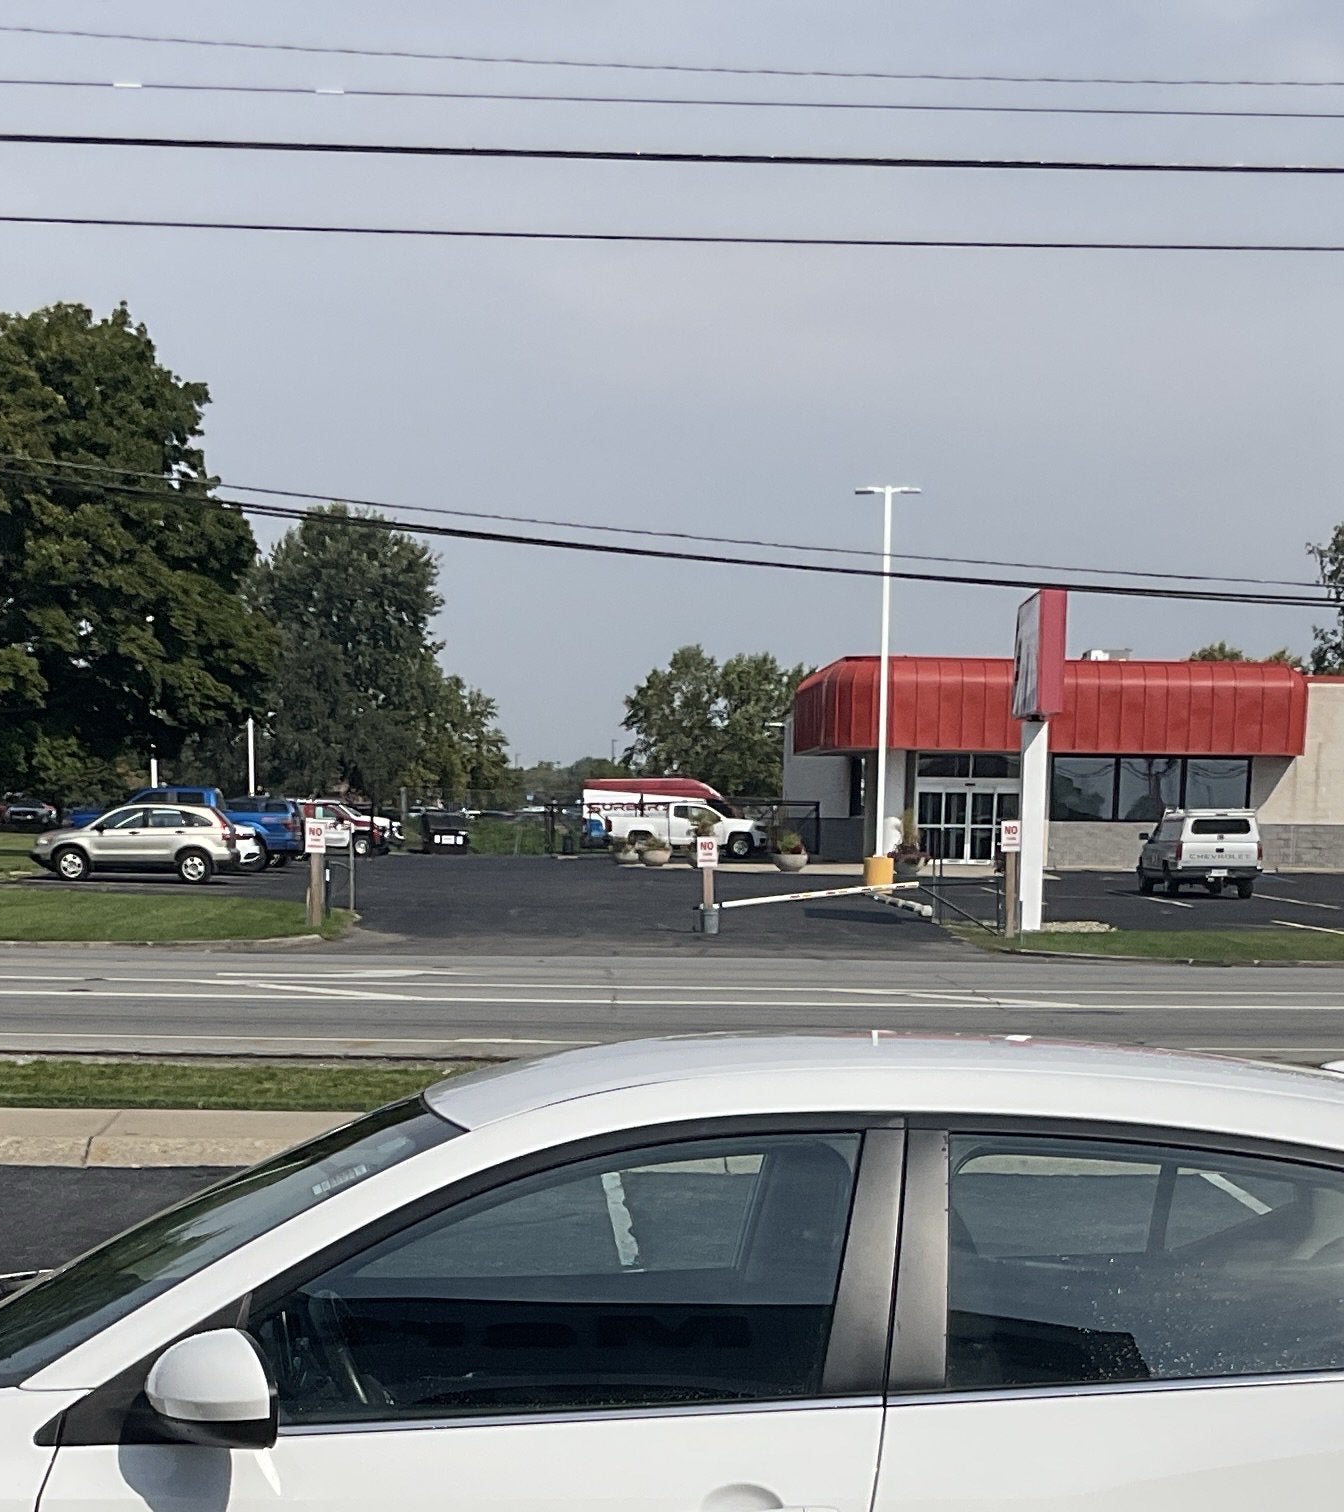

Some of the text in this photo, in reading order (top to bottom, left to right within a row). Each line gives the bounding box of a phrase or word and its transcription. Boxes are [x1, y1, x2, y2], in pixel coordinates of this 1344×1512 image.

[308, 827, 323, 836] NO
[1004, 825, 1018, 835] NO
[700, 841, 714, 850] NO
